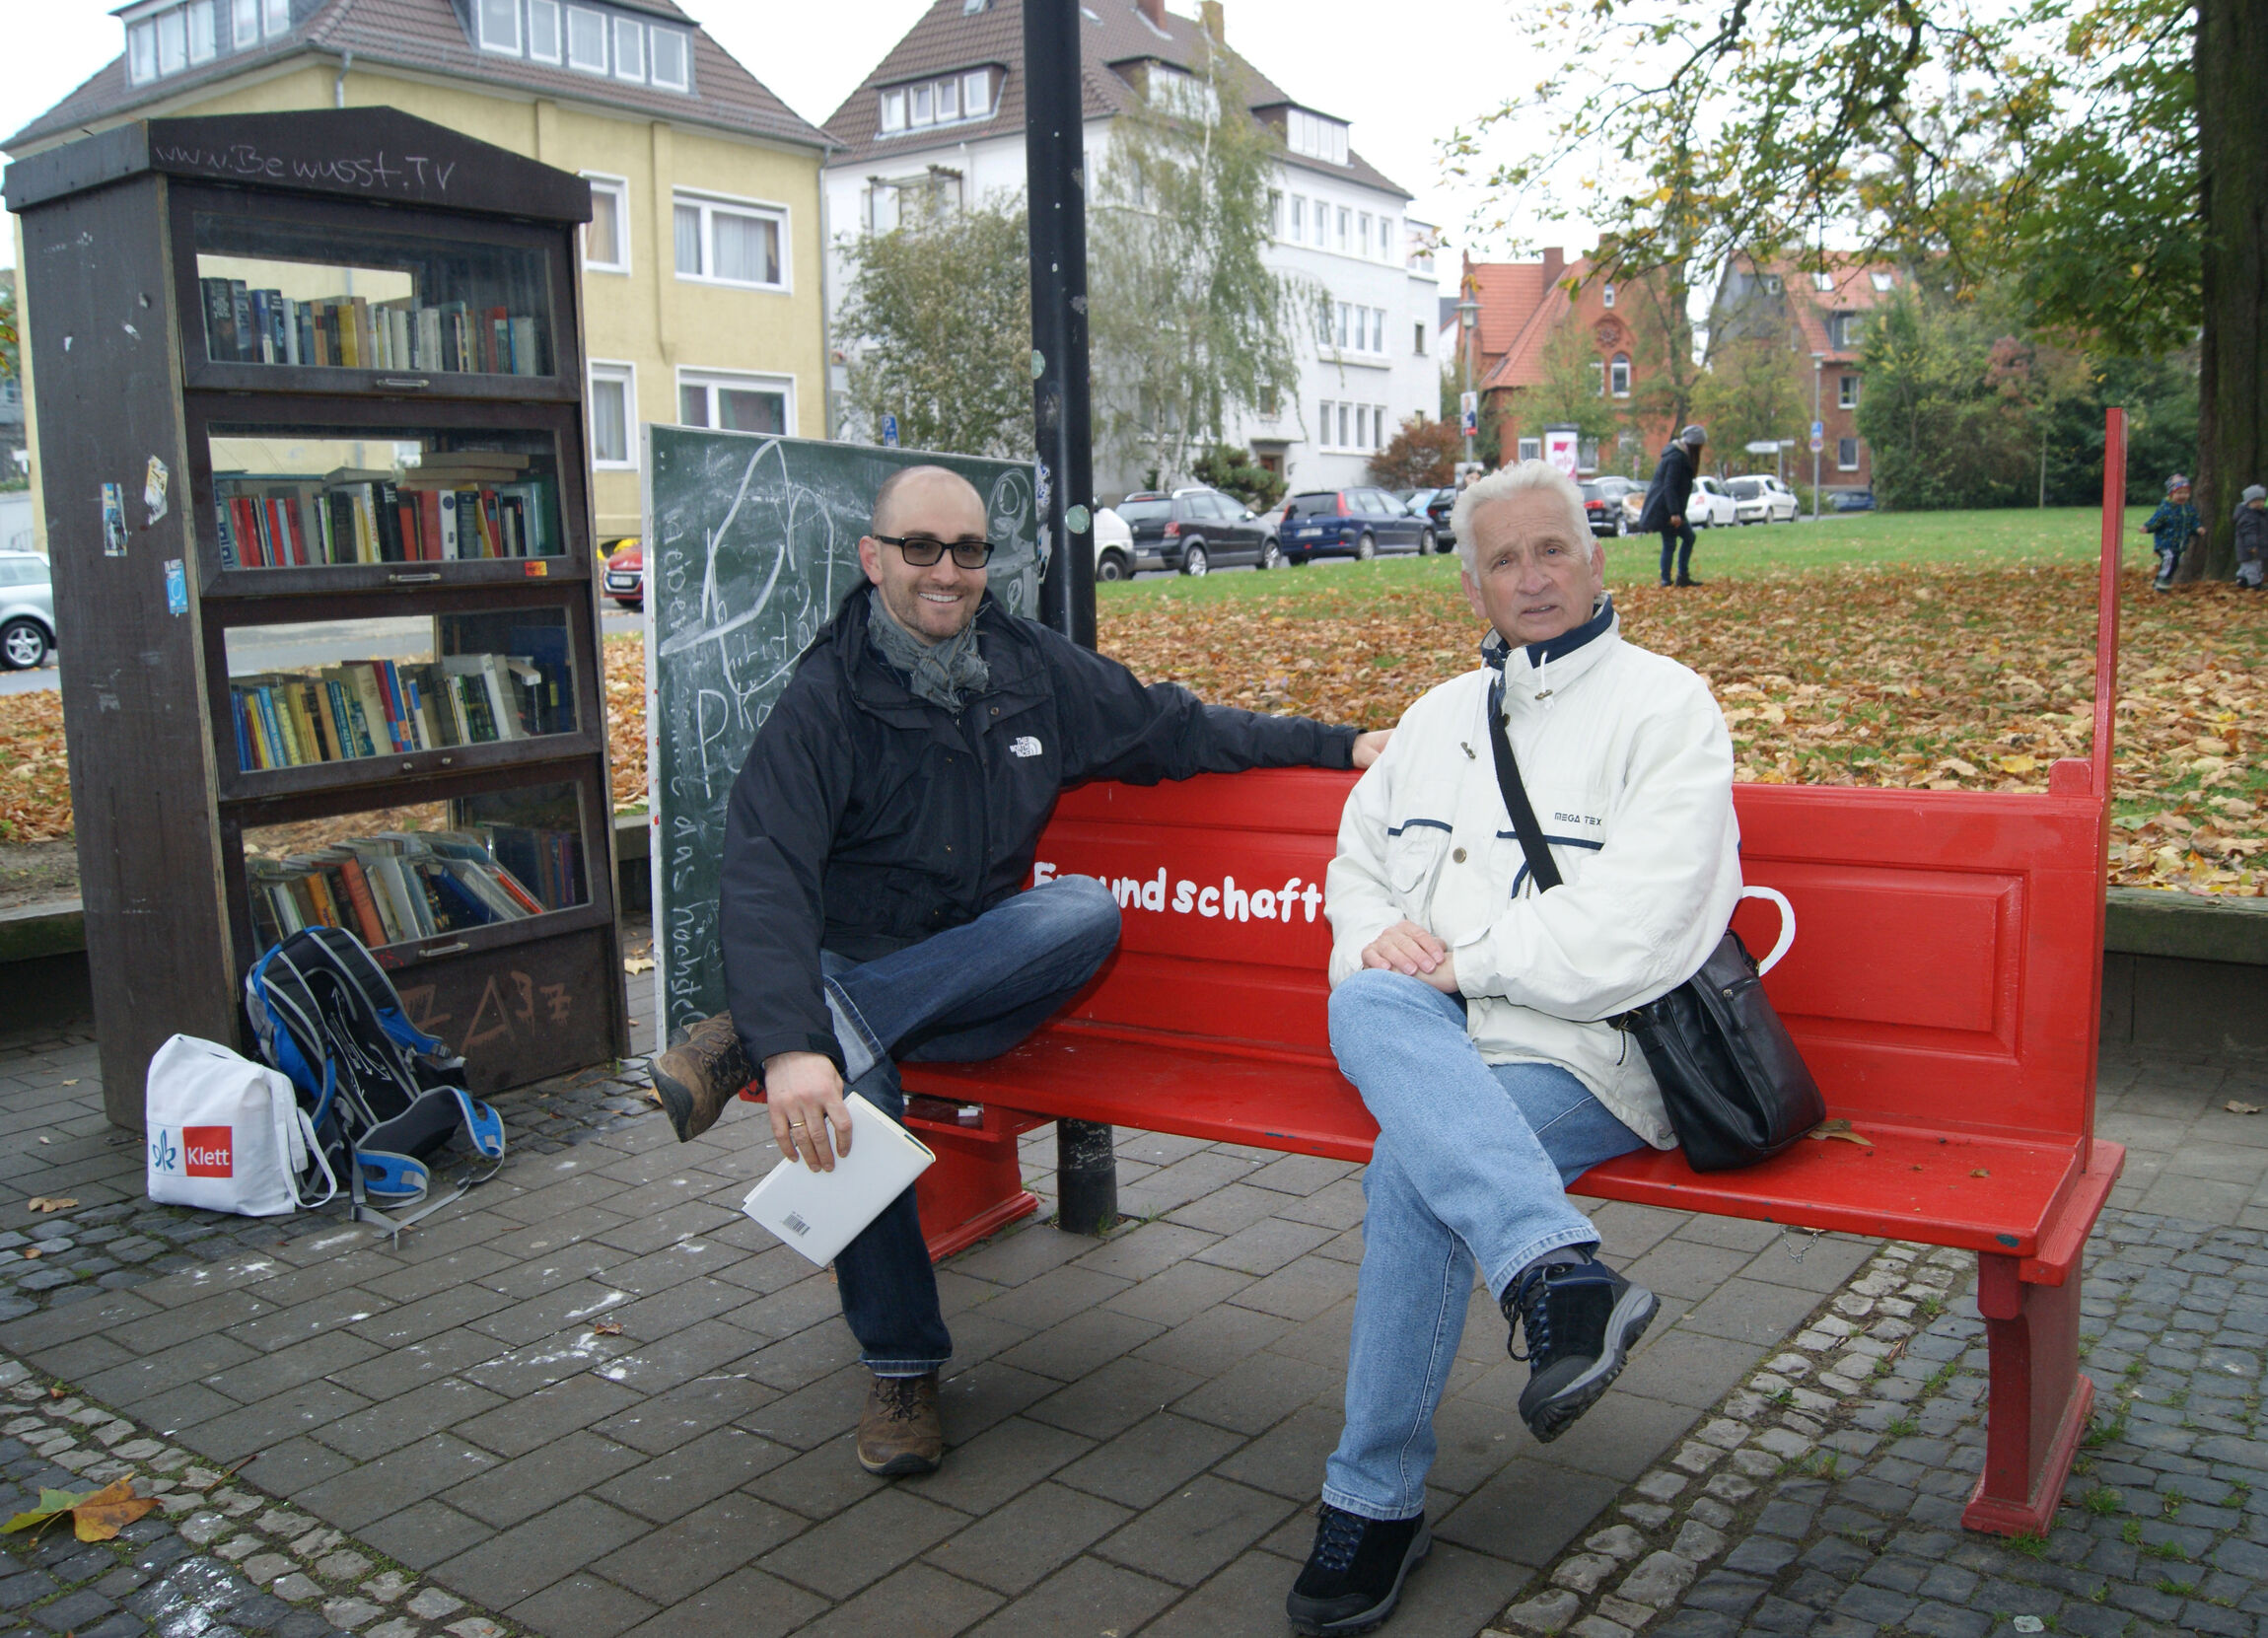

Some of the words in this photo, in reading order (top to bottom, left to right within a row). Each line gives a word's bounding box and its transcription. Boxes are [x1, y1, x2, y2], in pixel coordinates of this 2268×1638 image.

[1554, 812, 1580, 823] MEGA
[1584, 816, 1602, 826] TEX
[1034, 861, 1322, 923] Fndschaft
[187, 1146, 230, 1166] Klett
